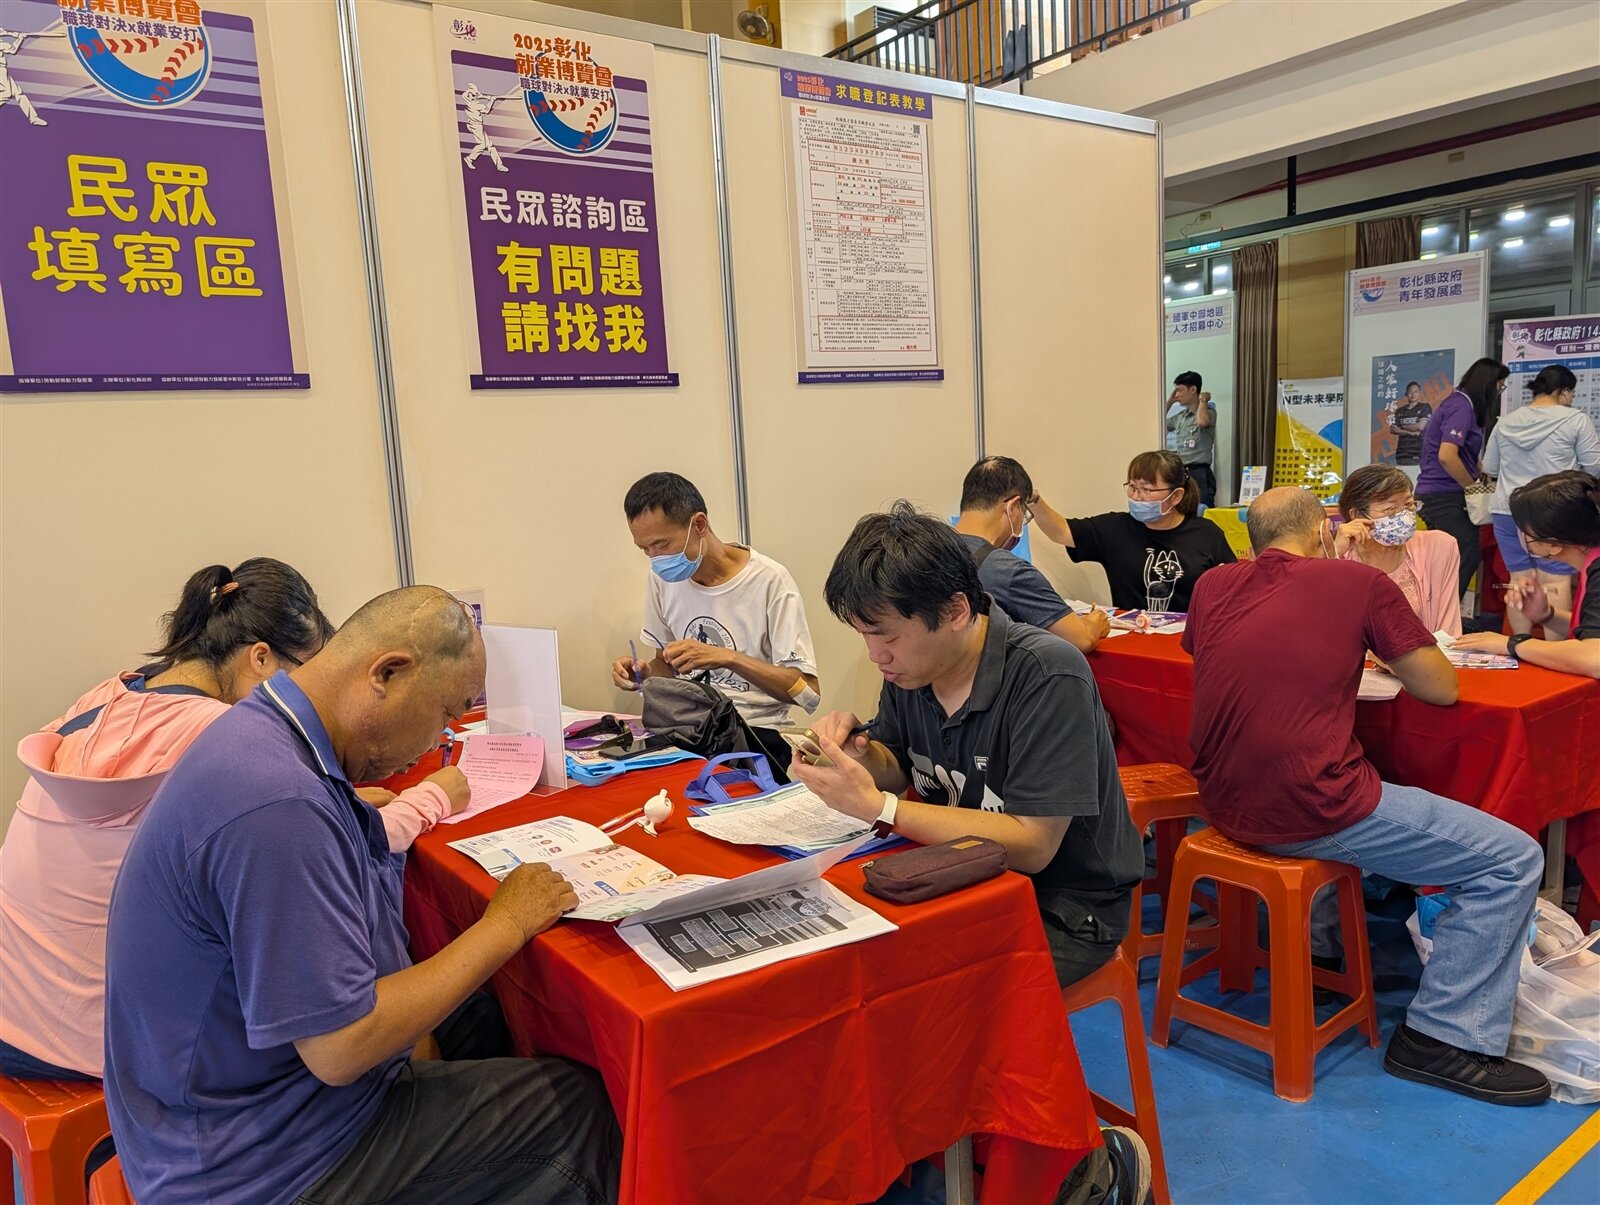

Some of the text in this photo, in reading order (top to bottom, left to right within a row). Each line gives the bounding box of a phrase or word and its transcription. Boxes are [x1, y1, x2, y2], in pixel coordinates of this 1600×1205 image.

[62, 10, 198, 42] 職球對決x就業安打
[513, 33, 592, 62] 2025彰化
[515, 52, 614, 88] 就業博覽會
[519, 77, 612, 102] 職球對決x就業安打
[835, 84, 926, 111] 求職登記表教學
[67, 154, 216, 226] 民眾
[480, 186, 650, 233] 民眾諮詢區
[28, 226, 263, 297] 填寫區
[496, 240, 644, 297] 有問題
[1399, 269, 1463, 289] 彰化縣政府
[1399, 284, 1462, 302] 青年發展處
[501, 301, 648, 353] 請找我
[1173, 306, 1224, 323] 國軍中部地區
[1173, 318, 1224, 335] 人才招募中心
[1533, 325, 1600, 342] 彰化縣政府114
